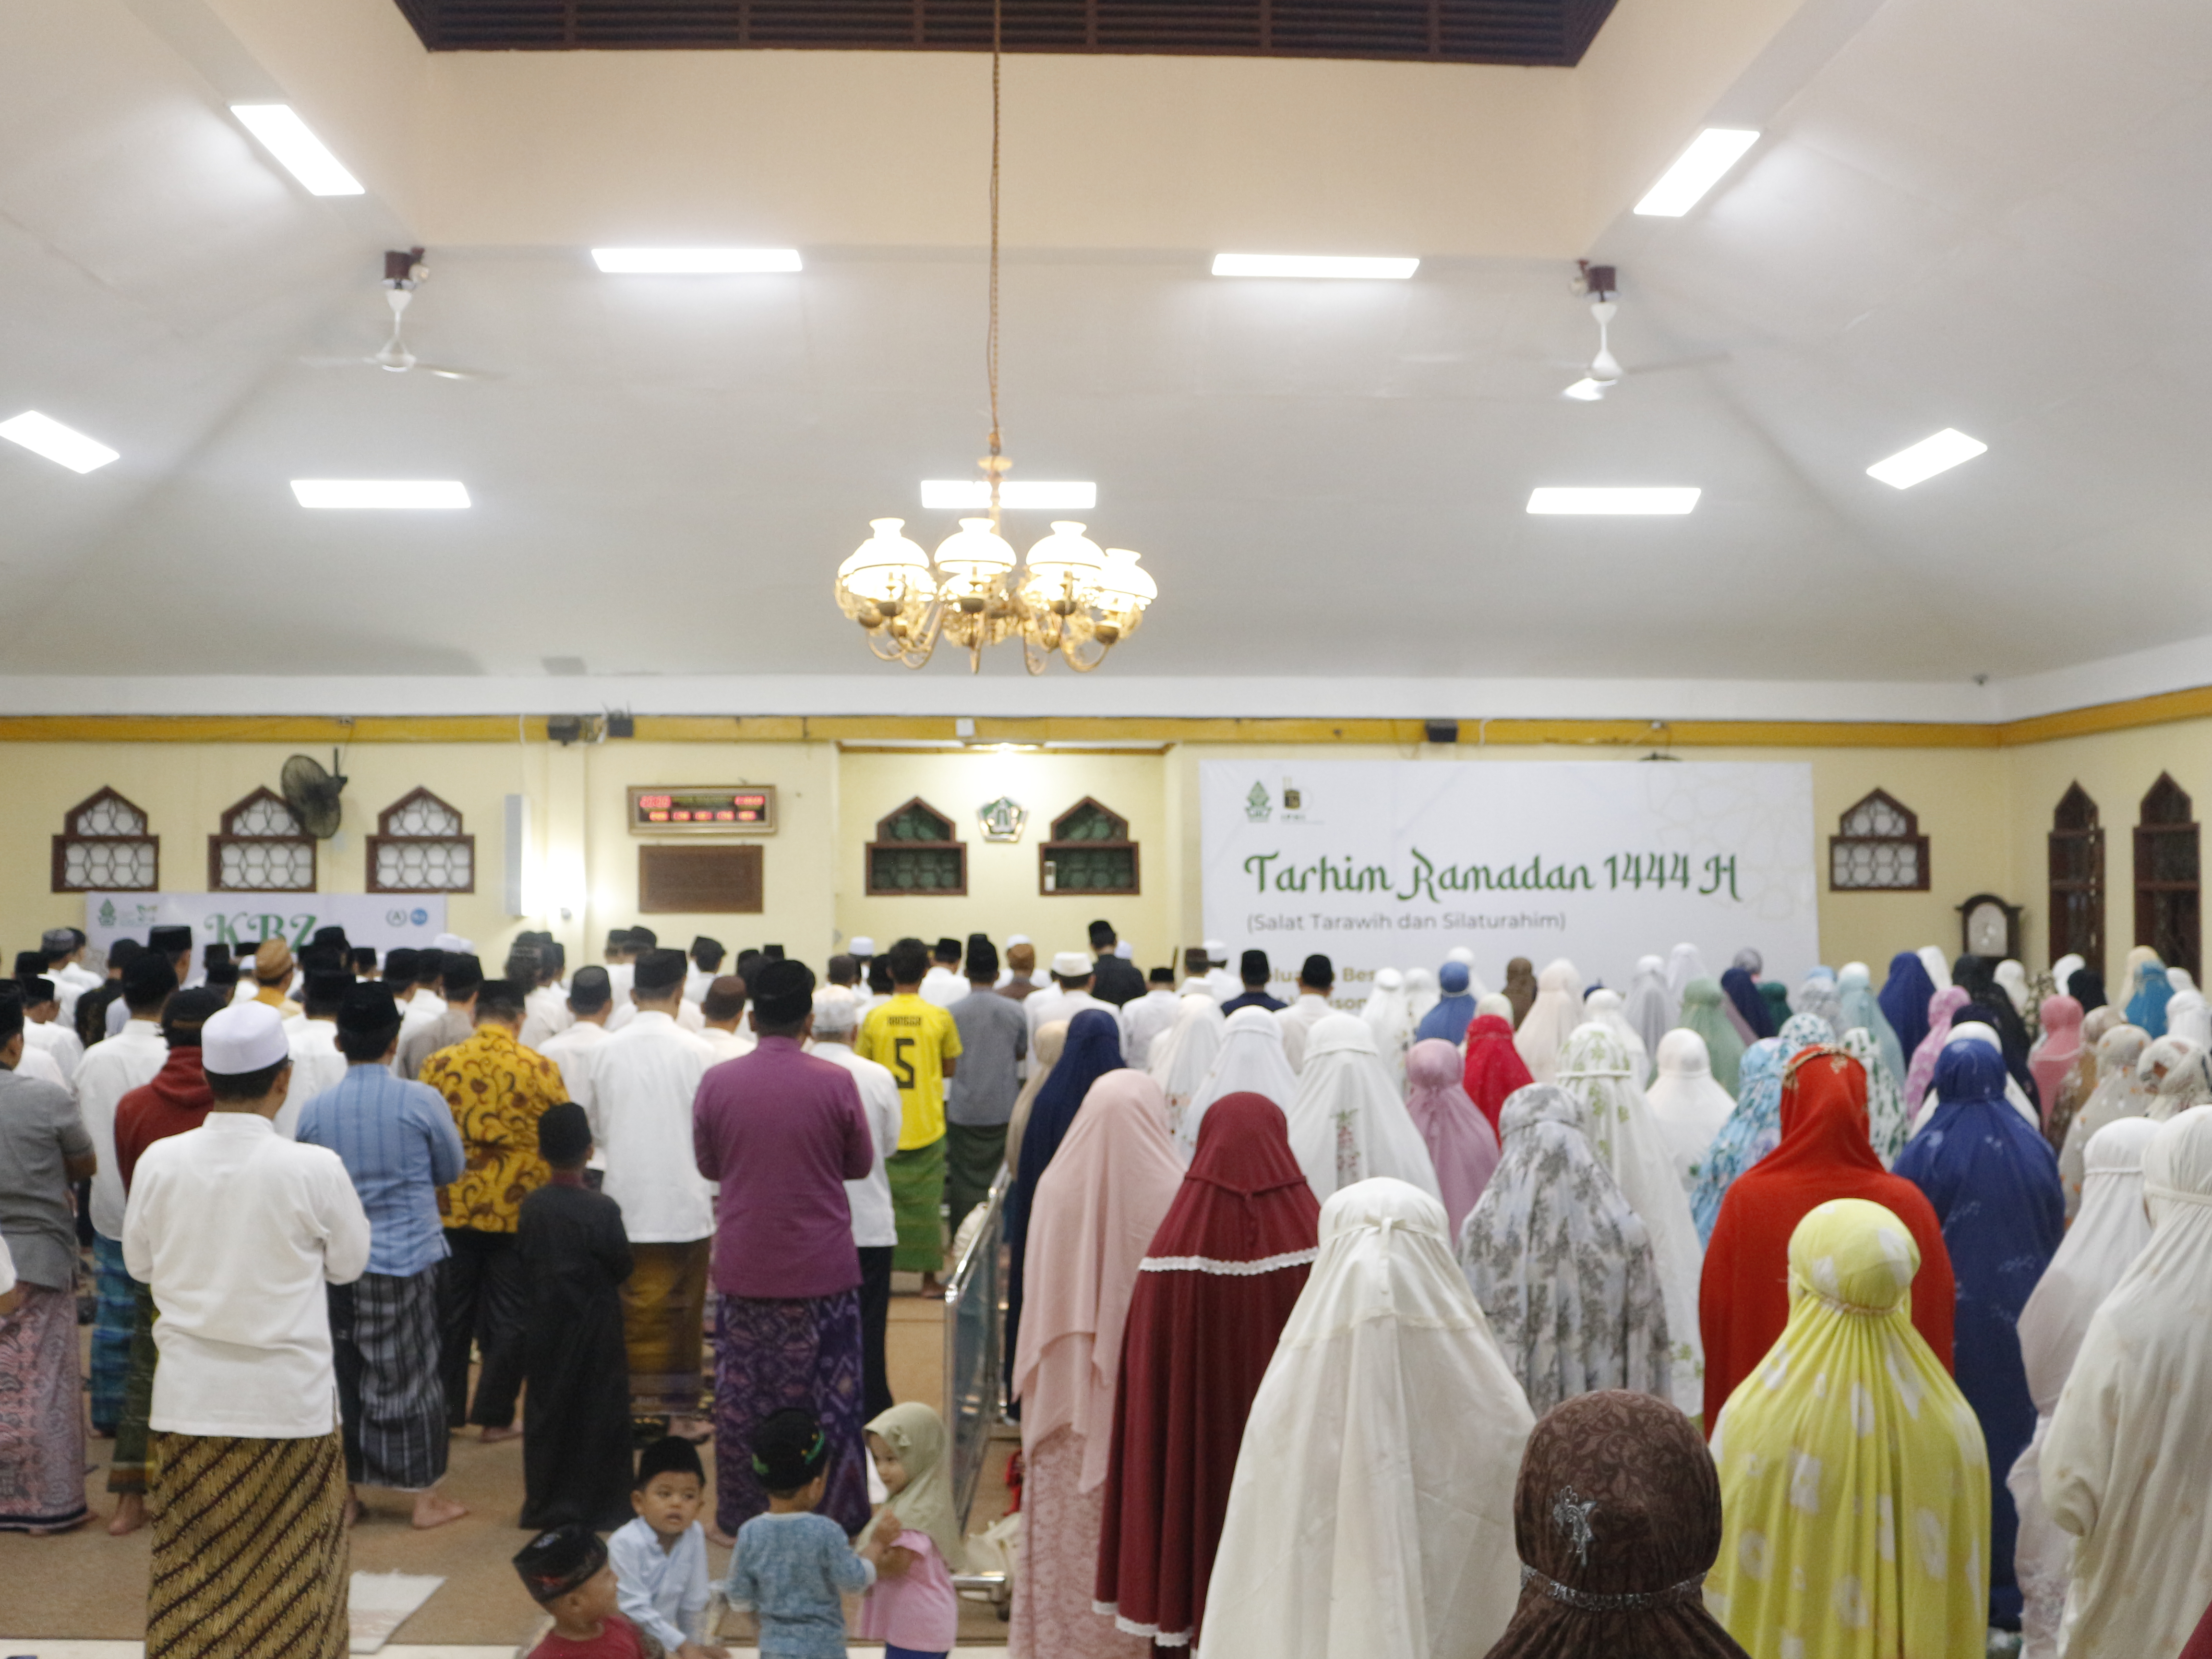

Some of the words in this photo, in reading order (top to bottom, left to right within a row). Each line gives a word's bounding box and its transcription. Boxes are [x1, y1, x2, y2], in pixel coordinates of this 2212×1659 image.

[1245, 851, 1393, 893] Tarhim
[1396, 847, 1596, 903] Ramadan
[1604, 853, 1691, 890] 1444
[1698, 854, 1742, 902] H
[1248, 914, 1304, 934] (Salat
[1310, 913, 1392, 930] Tarawih
[1397, 913, 1437, 930] dan
[1442, 913, 1566, 932] Silaturahim)
[895, 1038, 914, 1088] 5
